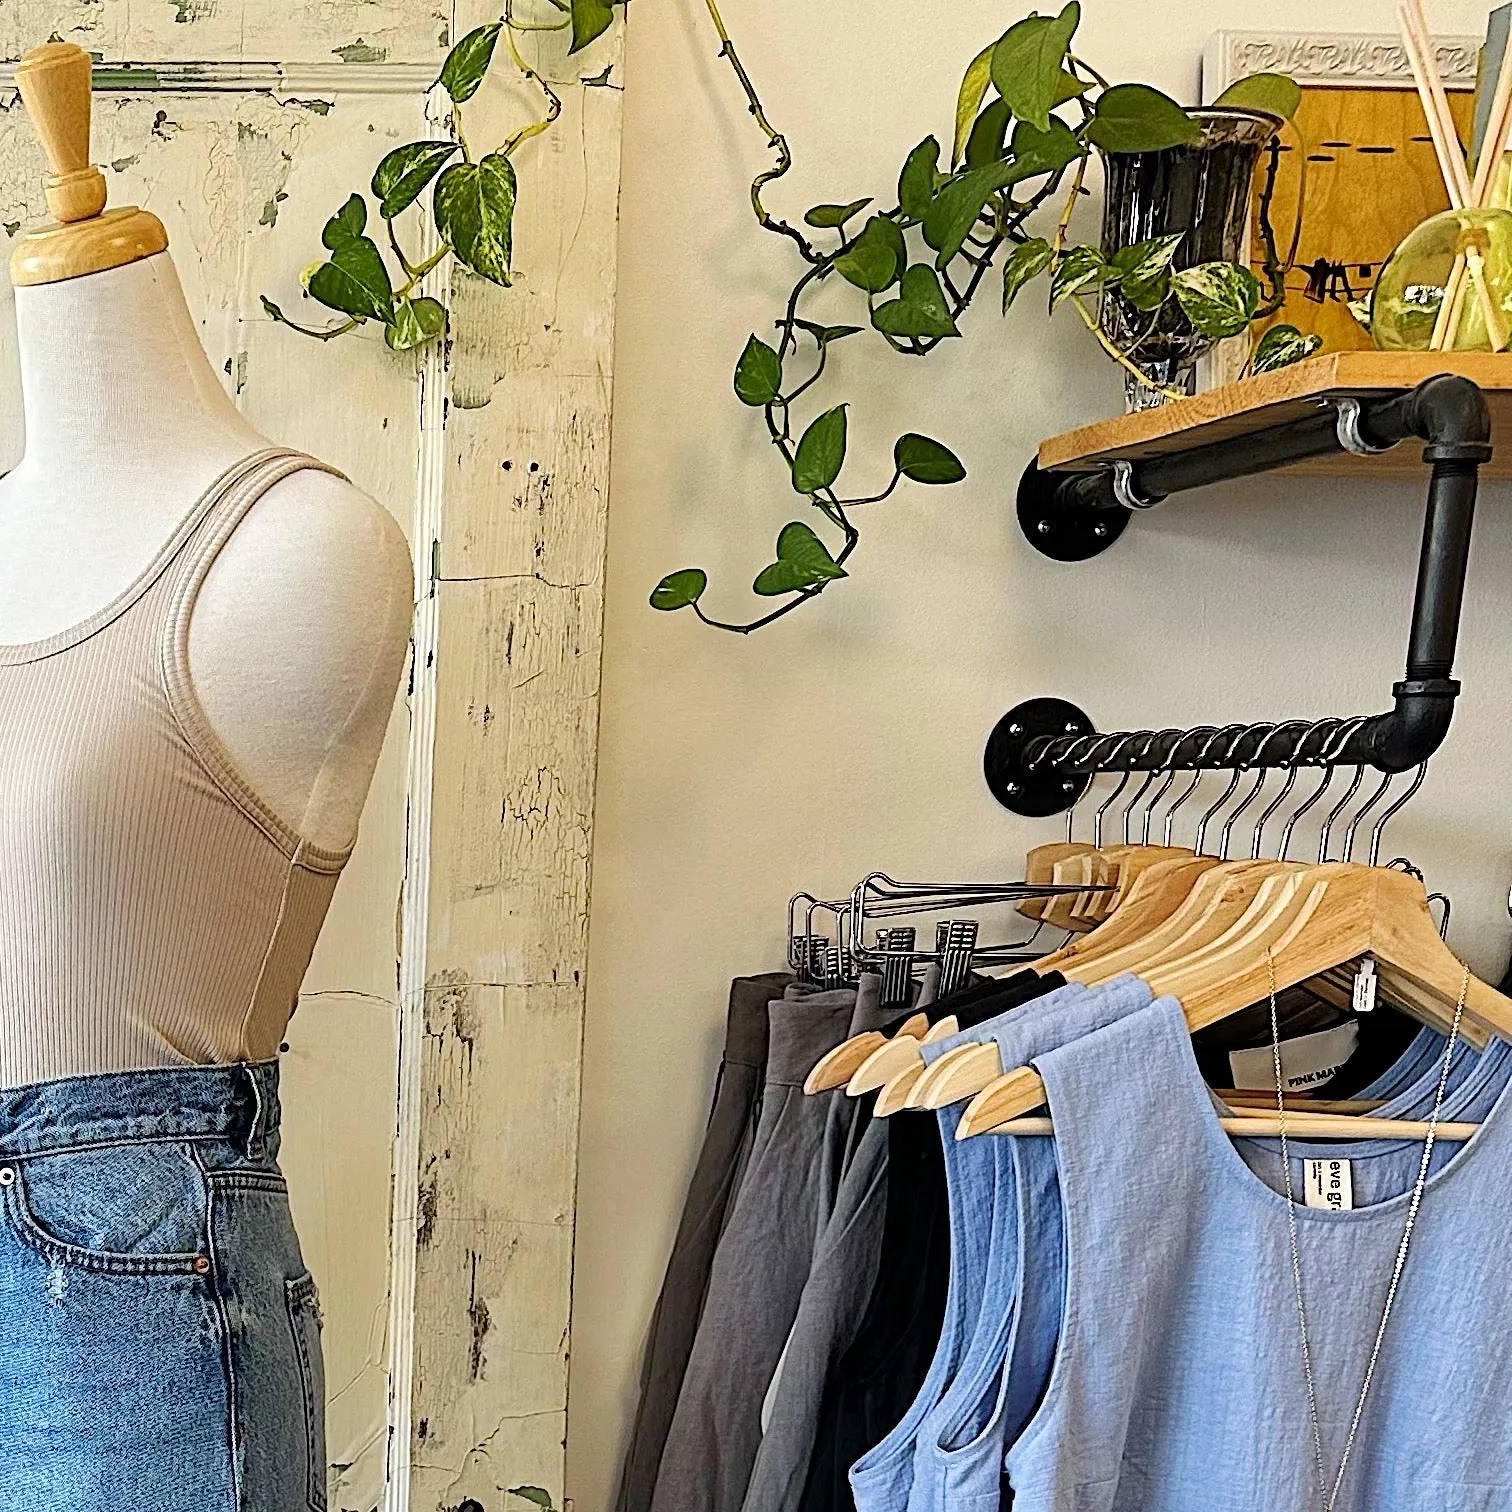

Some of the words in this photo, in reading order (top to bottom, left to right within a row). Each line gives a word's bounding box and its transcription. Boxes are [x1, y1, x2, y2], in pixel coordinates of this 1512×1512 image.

[1287, 1073, 1316, 1088] PINK
[1329, 1161, 1341, 1189] eve
[1326, 1192, 1342, 1211] gr
